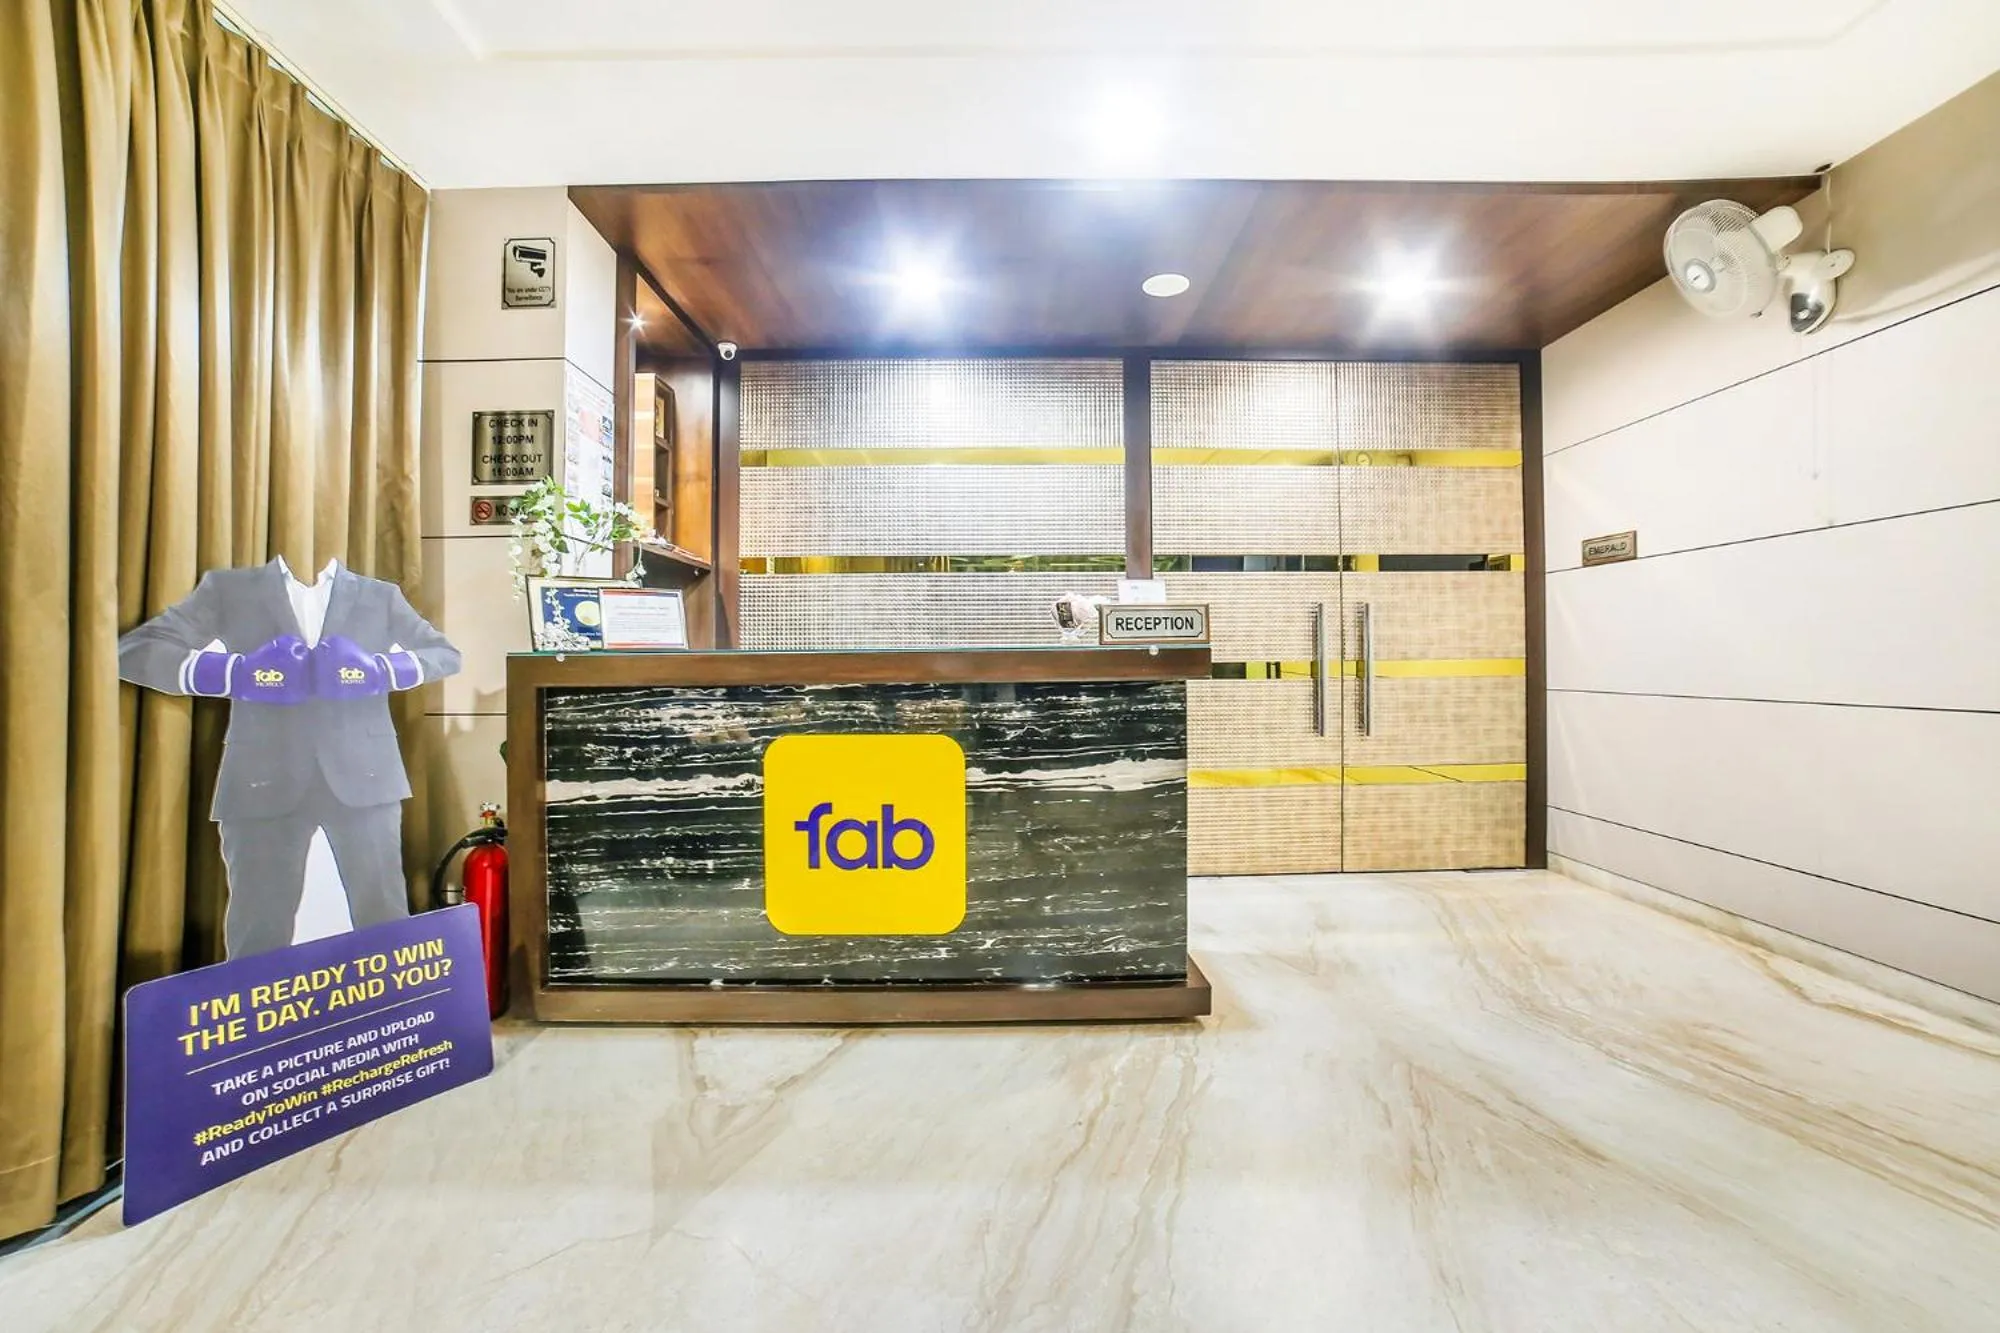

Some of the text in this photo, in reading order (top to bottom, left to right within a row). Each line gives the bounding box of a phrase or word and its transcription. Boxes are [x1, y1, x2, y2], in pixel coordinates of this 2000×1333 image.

[488, 419, 538, 429] CHECK IN
[482, 454, 543, 465] CHECK OUT
[496, 504, 508, 517] NO
[1588, 542, 1628, 556] EMERALD
[1115, 616, 1194, 631] RECEPTION
[252, 668, 285, 682] fab
[338, 667, 365, 680] fab
[794, 802, 935, 871] fab
[189, 938, 445, 1027] I'M READY TO WIN
[177, 958, 453, 1057] THE DAY. AND YOU?
[211, 1010, 436, 1096] TAKE A PICTURE AND UPLOAD
[241, 1033, 420, 1107] ON SOCIAL MEDIA WITH
[193, 1039, 454, 1146] #ReadyToWin #RechargeRefresh
[200, 1057, 452, 1167] AND COLLECT A SURPRISE GIFT!
